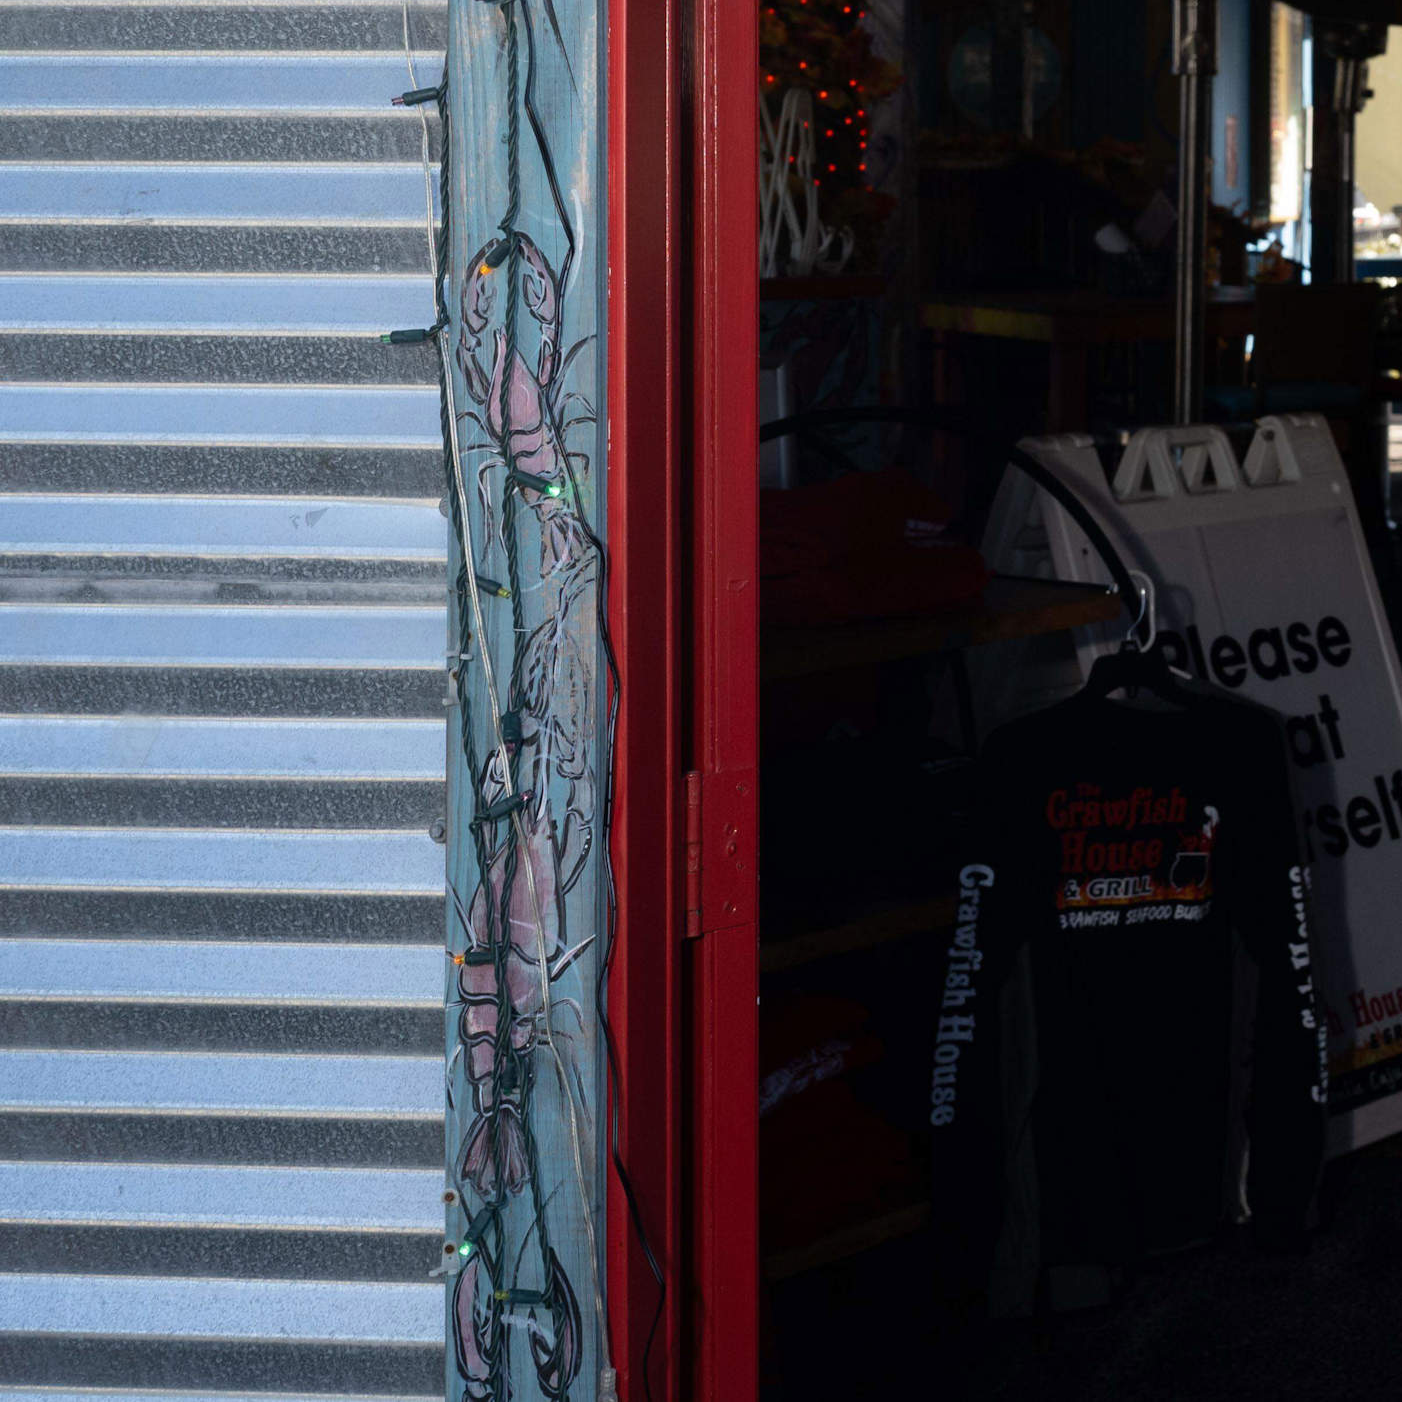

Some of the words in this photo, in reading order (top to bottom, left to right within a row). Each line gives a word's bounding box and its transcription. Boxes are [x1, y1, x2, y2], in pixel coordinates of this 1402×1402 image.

[1046, 785, 1189, 831] Crawfish
[1058, 831, 1165, 875] House
[1086, 875, 1154, 901] GRILL
[942, 863, 995, 1009] Crawfish
[929, 1013, 976, 1127] House
